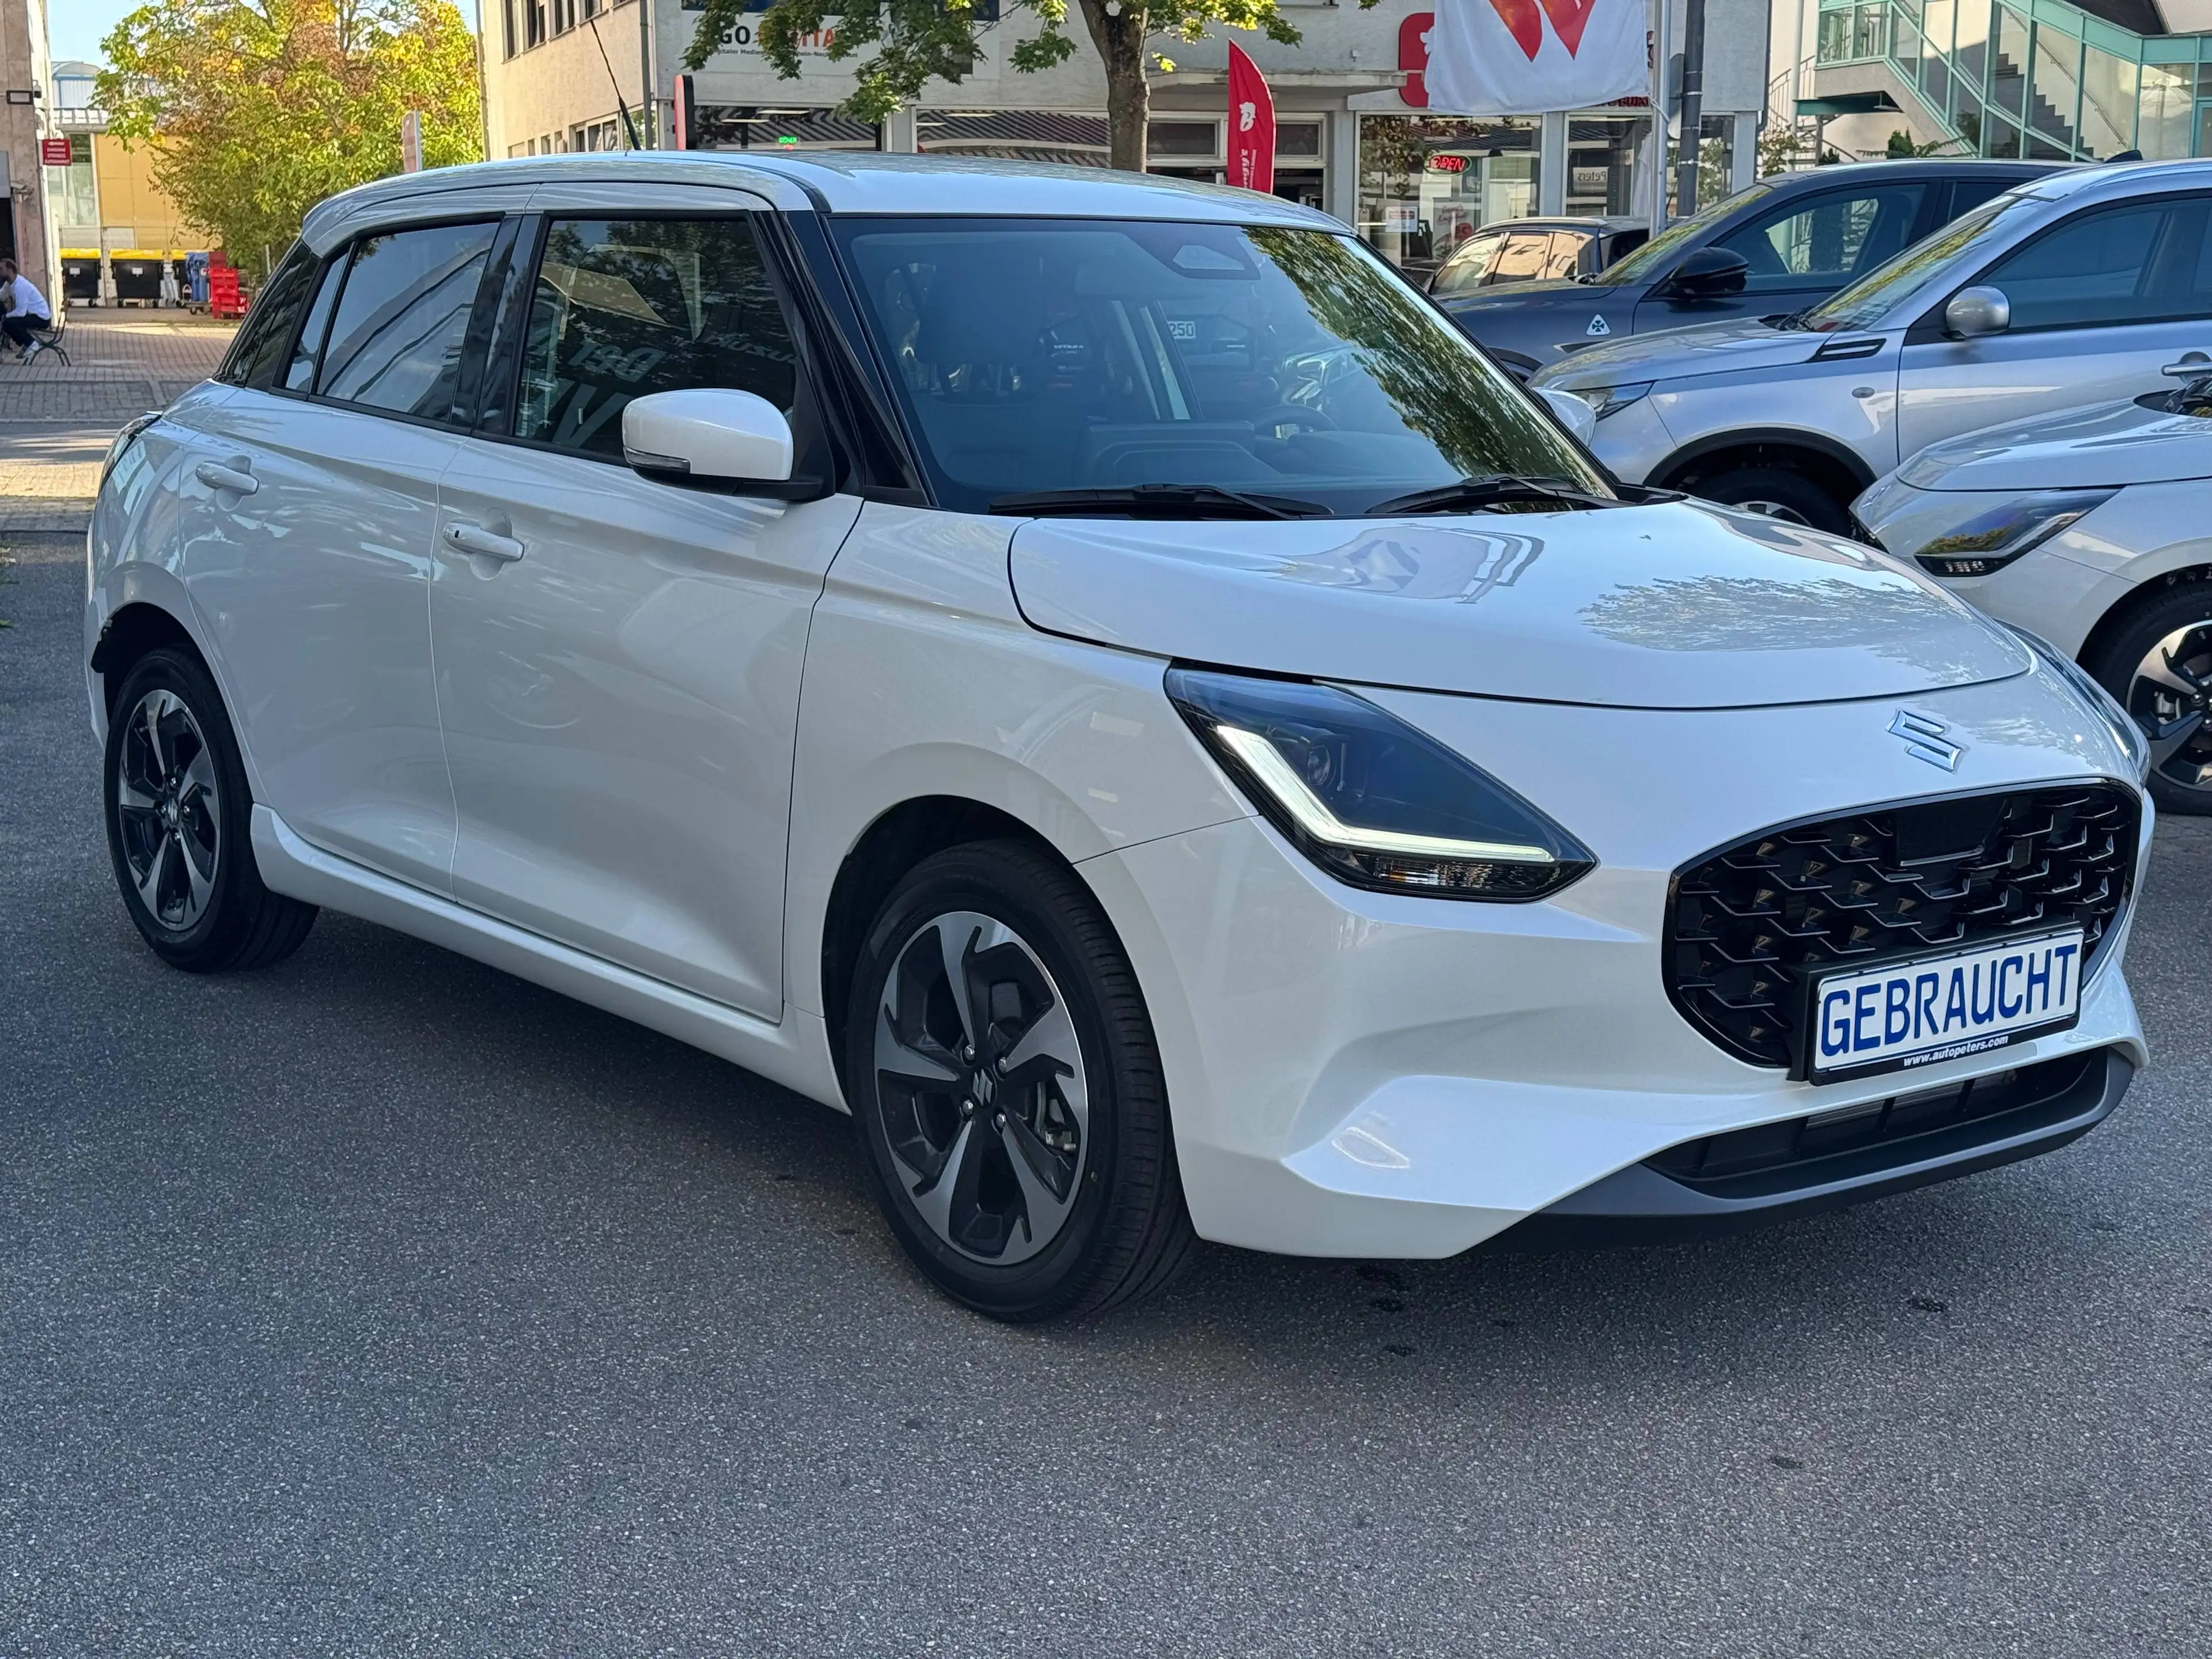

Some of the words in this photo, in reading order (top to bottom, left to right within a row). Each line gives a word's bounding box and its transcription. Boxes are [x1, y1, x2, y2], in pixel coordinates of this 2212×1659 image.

[1430, 155, 1466, 172] OPEN
[1821, 943, 2078, 1057] GEBRAUCHT
[1903, 1035, 2009, 1067] www.autopeters.com
